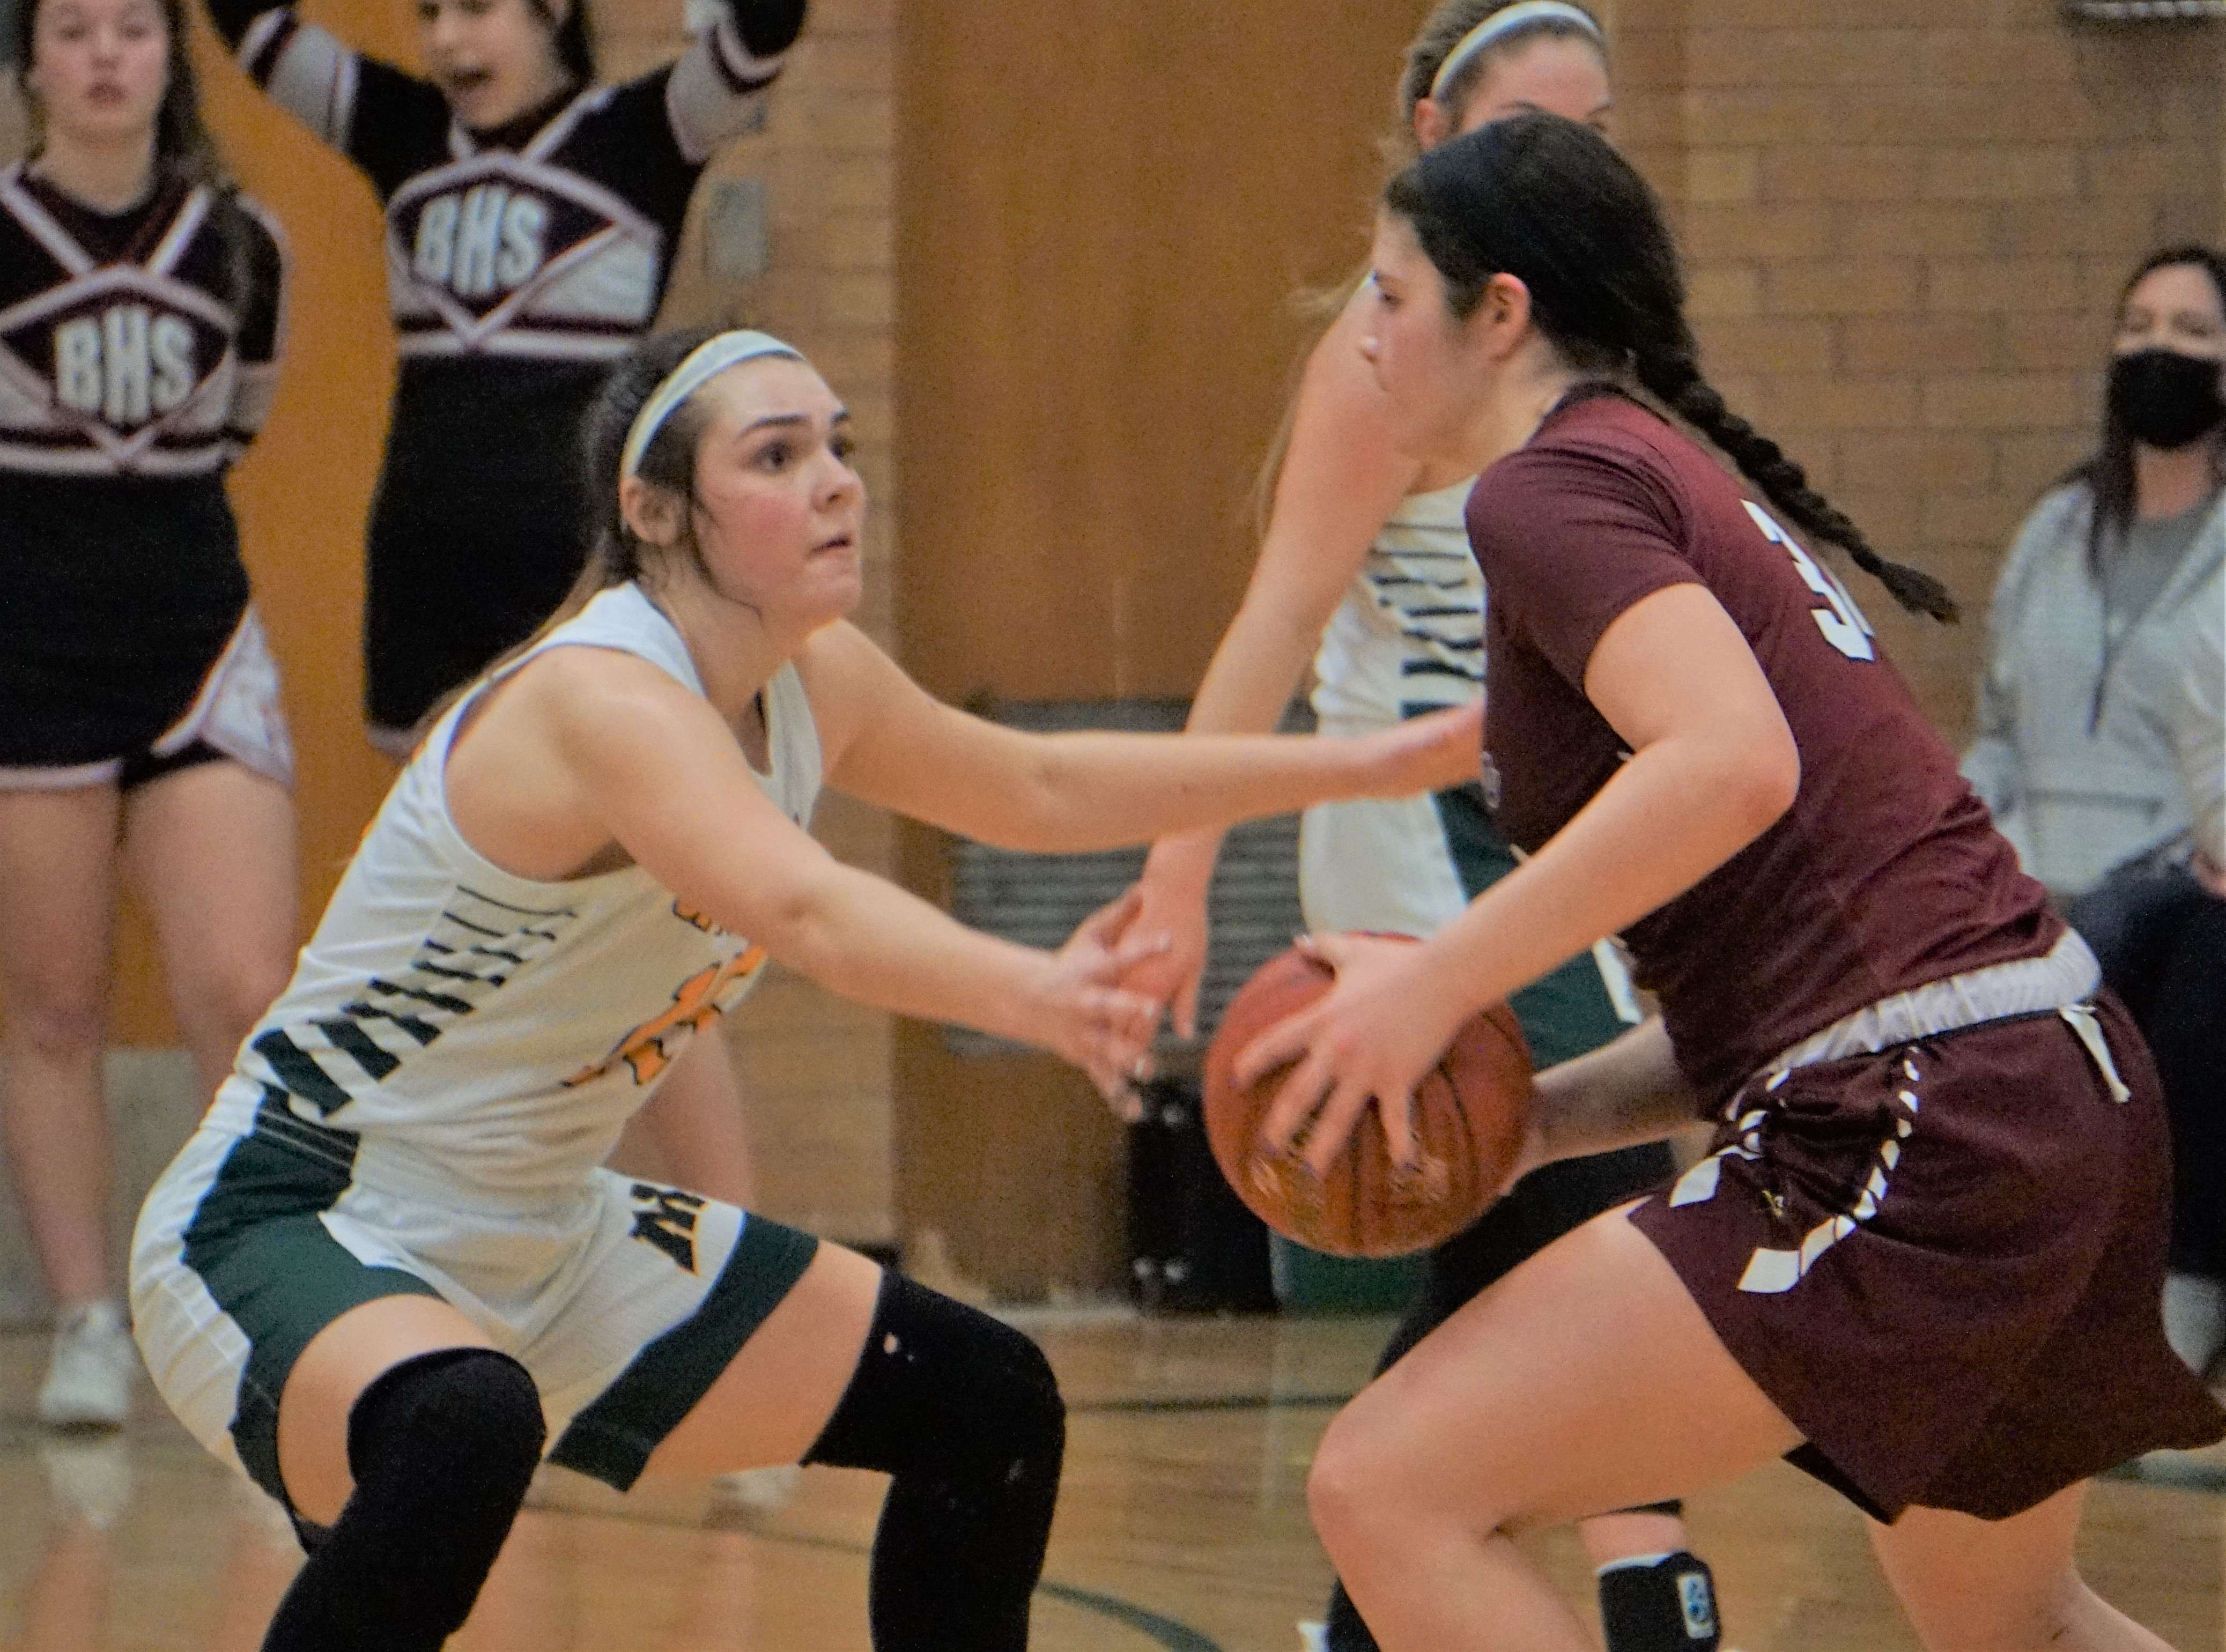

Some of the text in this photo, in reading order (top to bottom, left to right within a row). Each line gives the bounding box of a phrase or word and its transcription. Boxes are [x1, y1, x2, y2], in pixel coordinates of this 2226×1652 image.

[415, 185, 545, 296] BHS
[54, 303, 194, 421] BHS
[1739, 499, 1875, 661] 3
